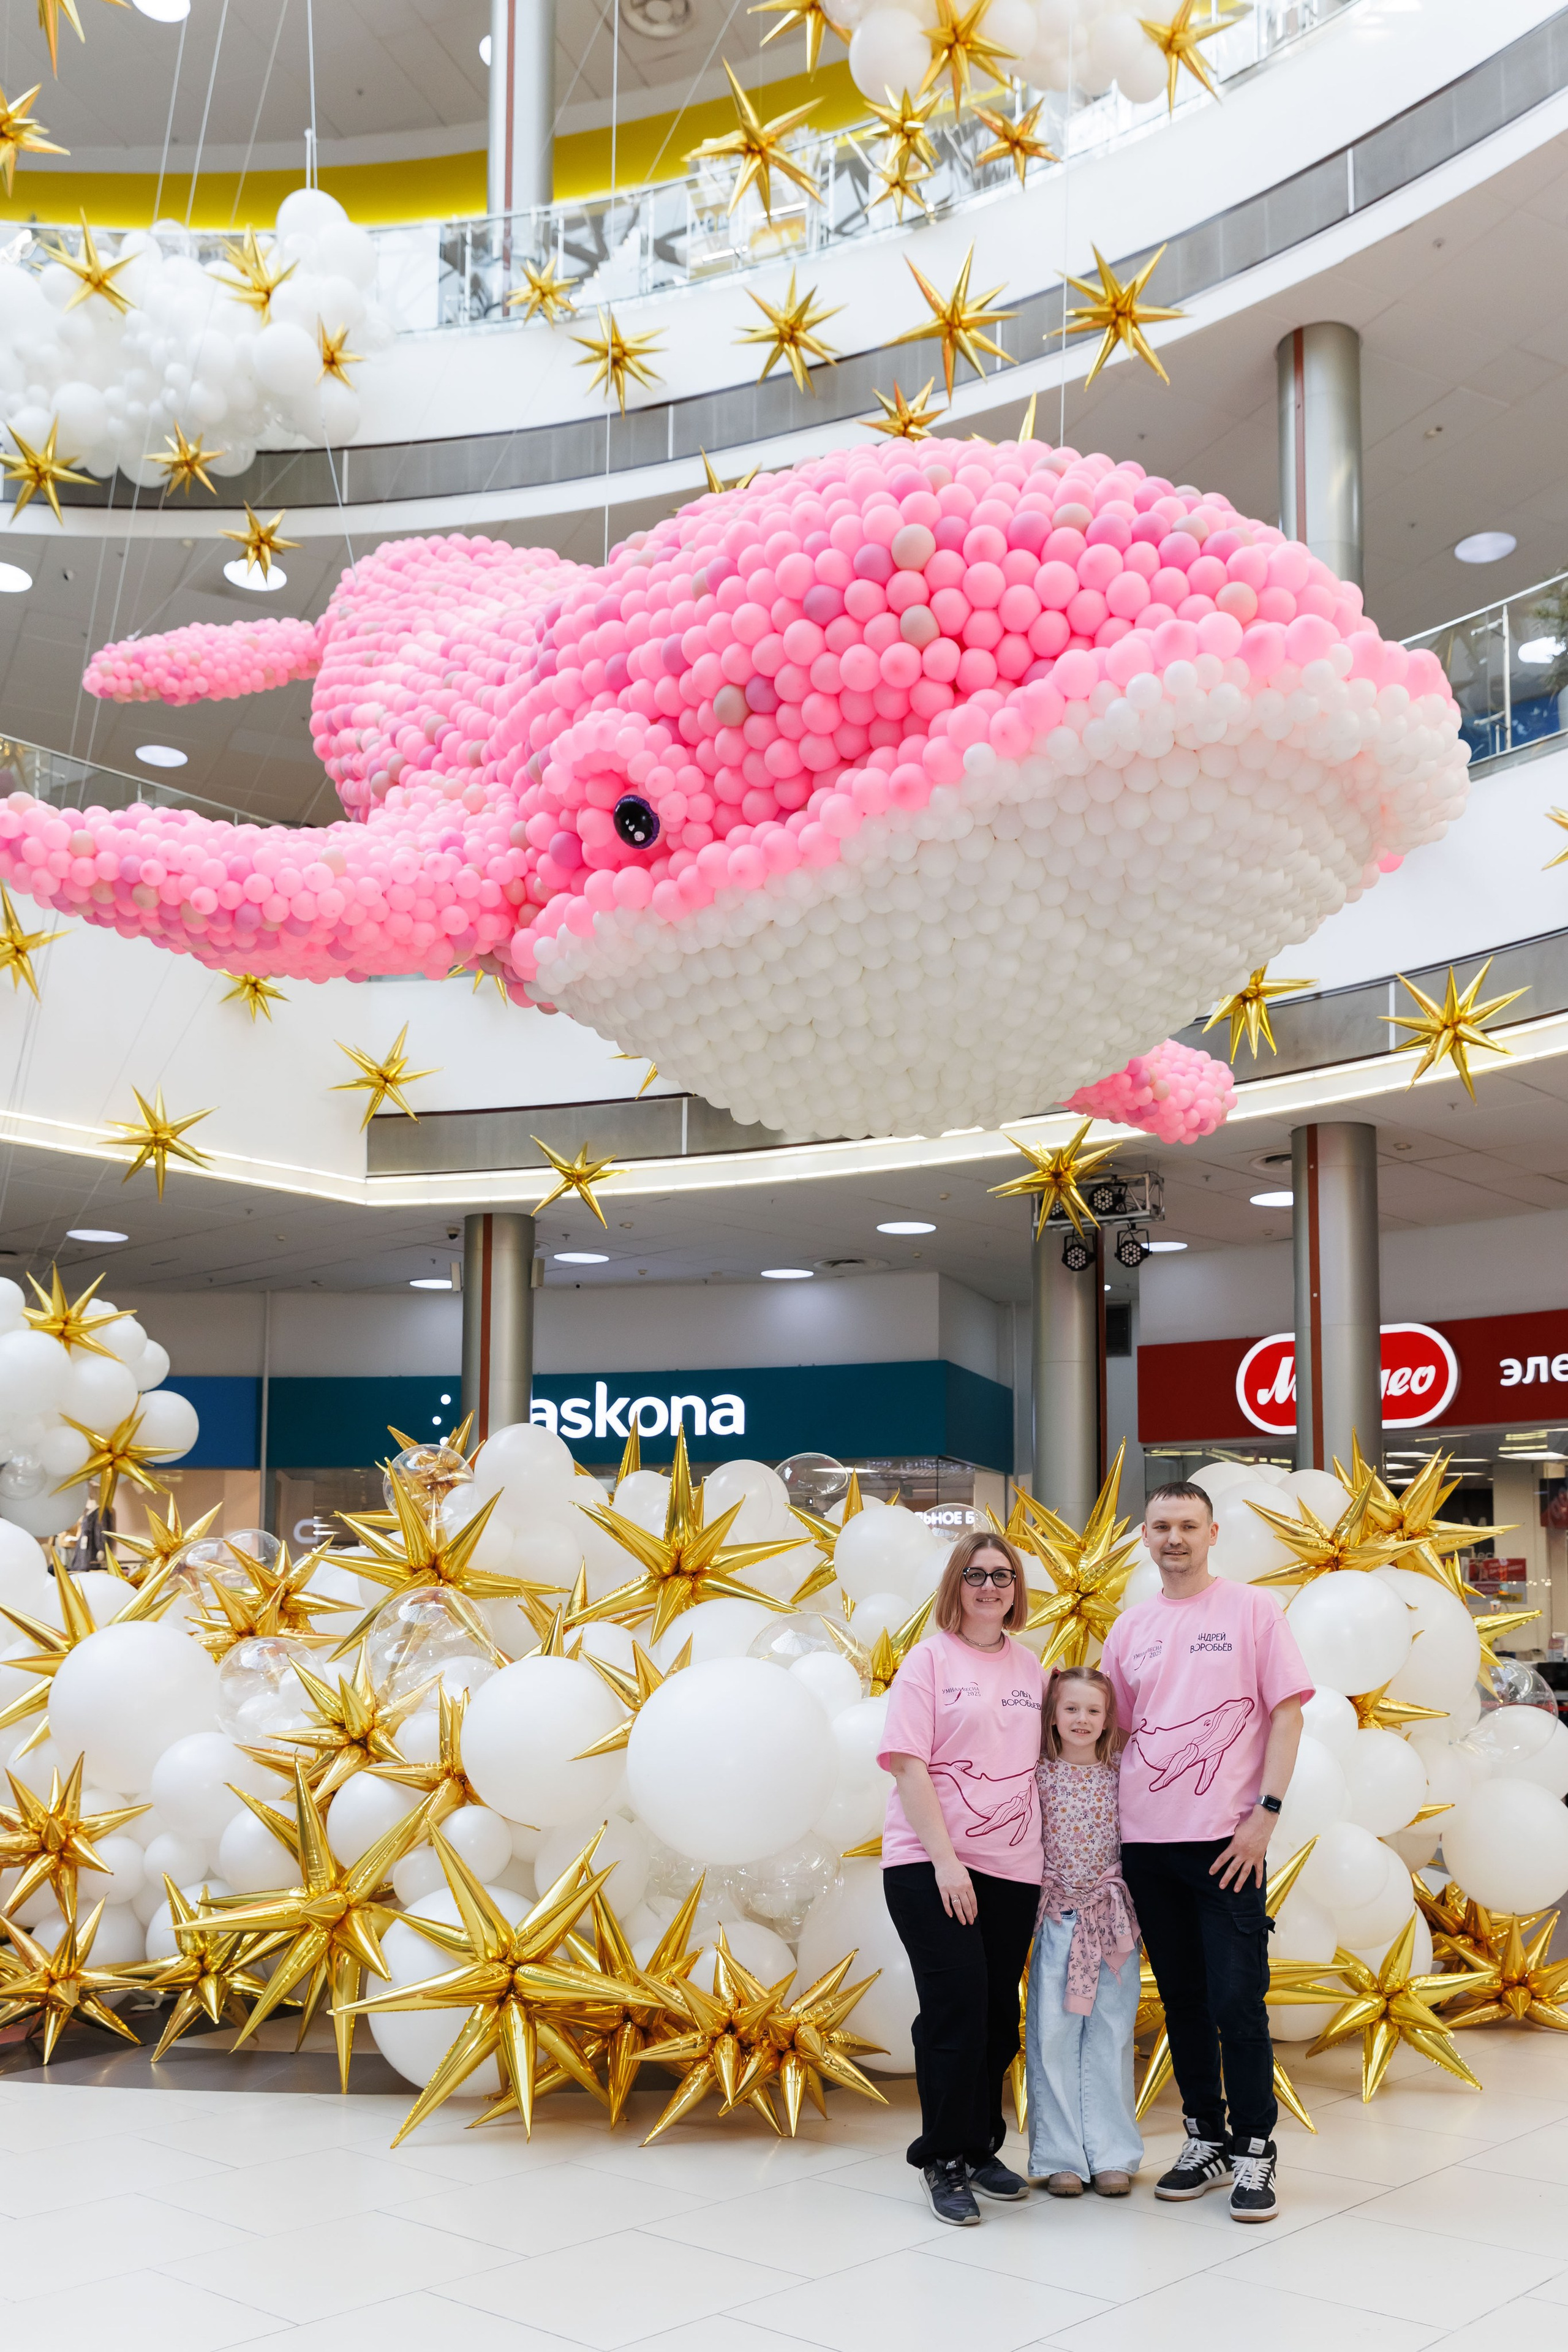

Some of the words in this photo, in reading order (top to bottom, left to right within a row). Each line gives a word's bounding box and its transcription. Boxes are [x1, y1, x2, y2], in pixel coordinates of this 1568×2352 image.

[530, 1381, 745, 1438] askona
[1190, 1643, 1232, 1653] ВОРОБЬЁВ
[1149, 1649, 1162, 1658] 2025
